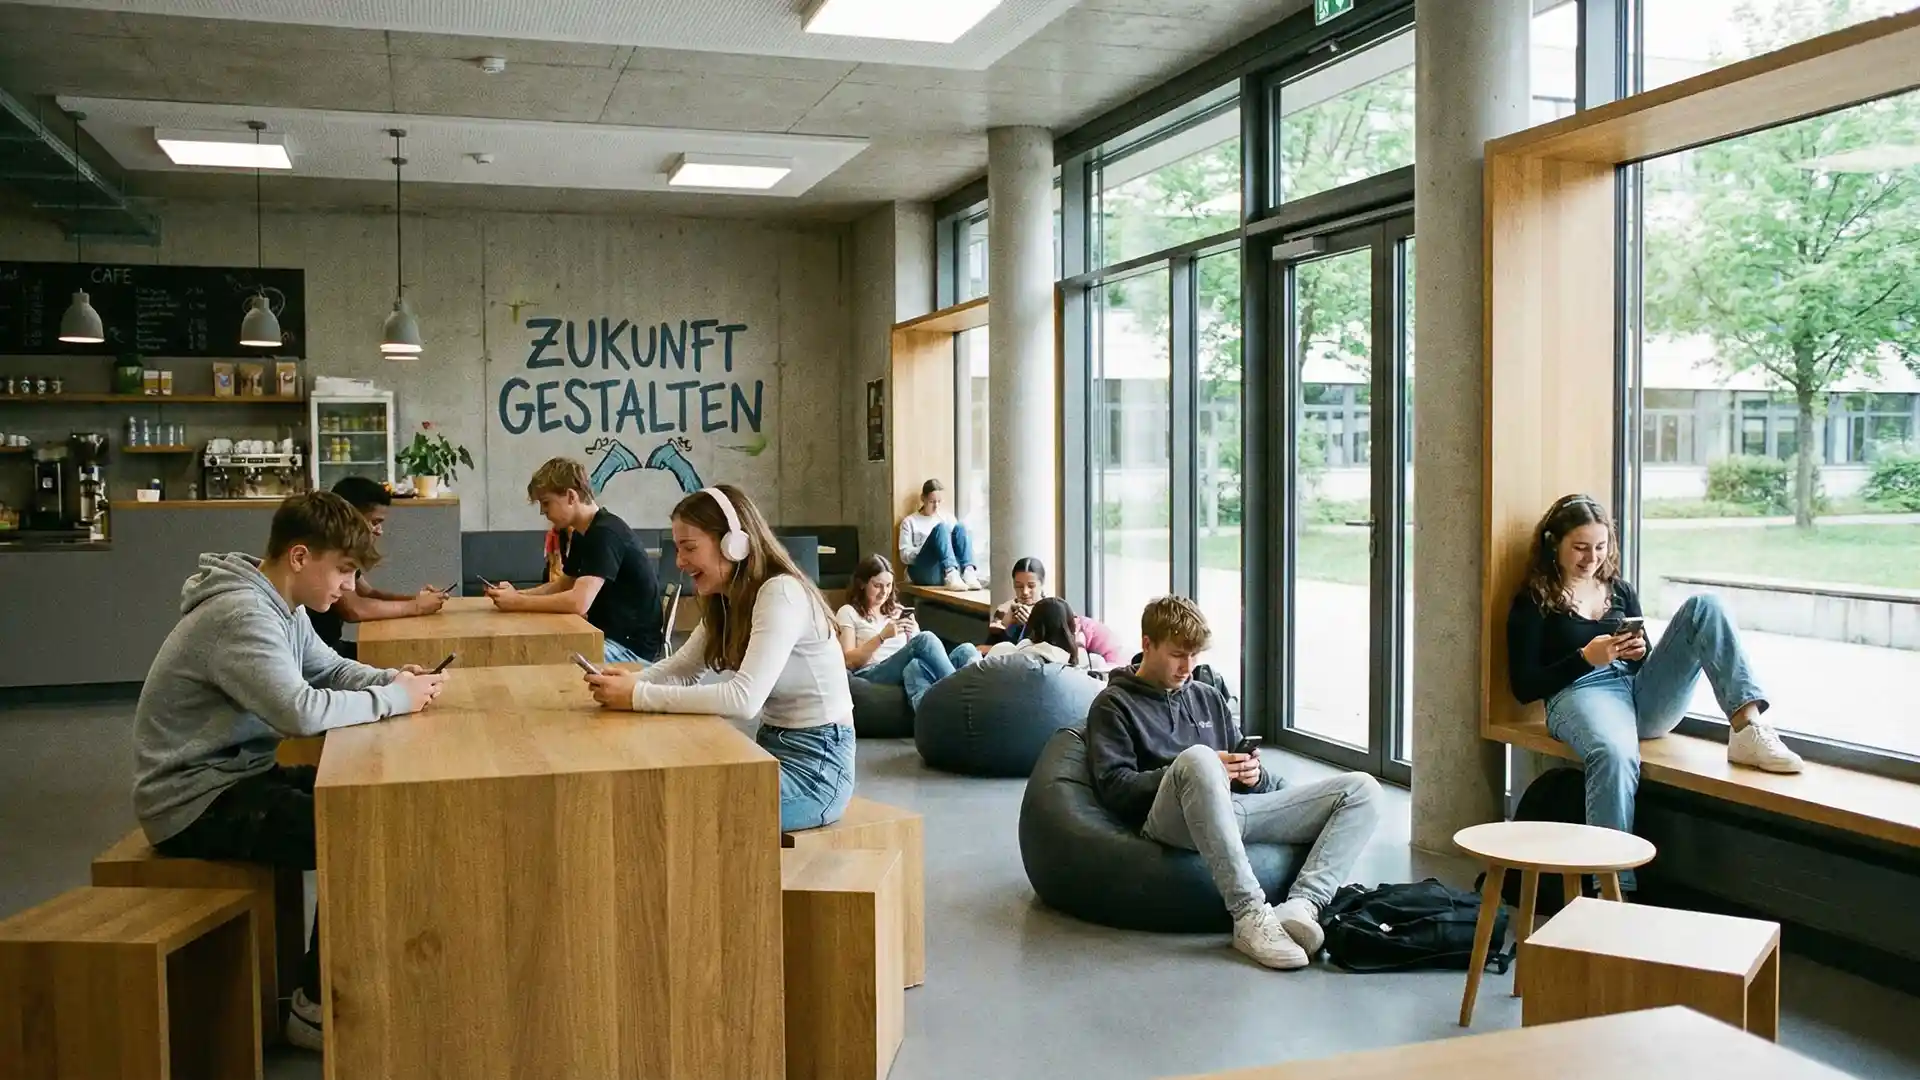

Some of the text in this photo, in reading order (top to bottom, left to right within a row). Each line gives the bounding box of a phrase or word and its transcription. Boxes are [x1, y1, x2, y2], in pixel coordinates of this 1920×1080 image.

[91, 267, 133, 285] CAFE
[526, 317, 748, 372] ZUKUNFT
[499, 377, 763, 434] GESTALTEN
